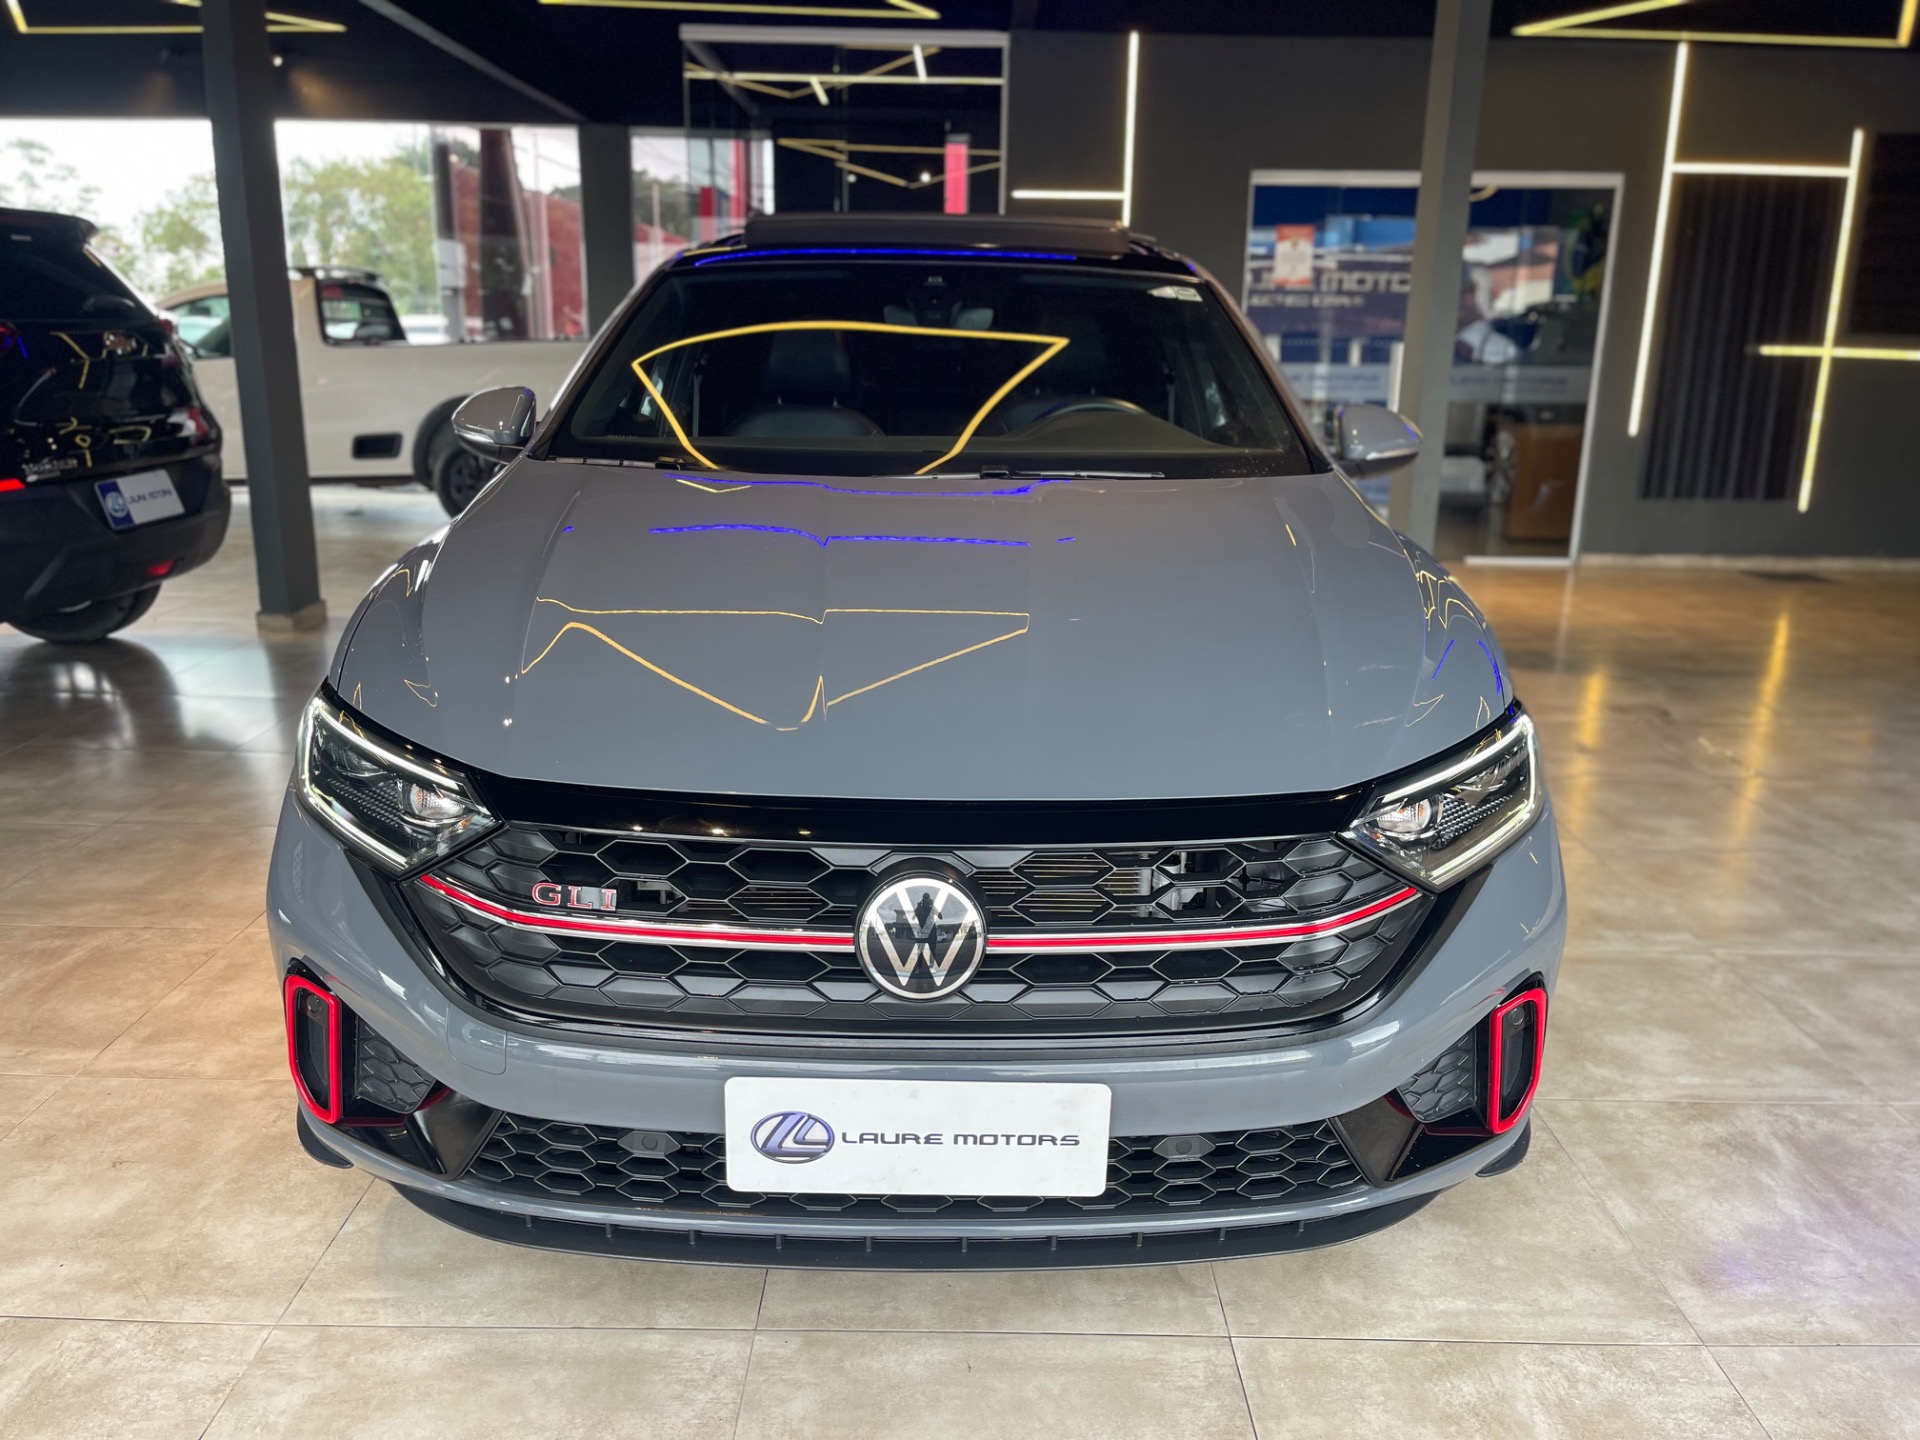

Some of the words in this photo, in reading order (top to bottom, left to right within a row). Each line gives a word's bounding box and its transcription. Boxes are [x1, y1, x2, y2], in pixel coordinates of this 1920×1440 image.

[532, 882, 617, 911] GLI
[842, 1132, 943, 1145] LAURE
[953, 1133, 1081, 1146] MOTORS
